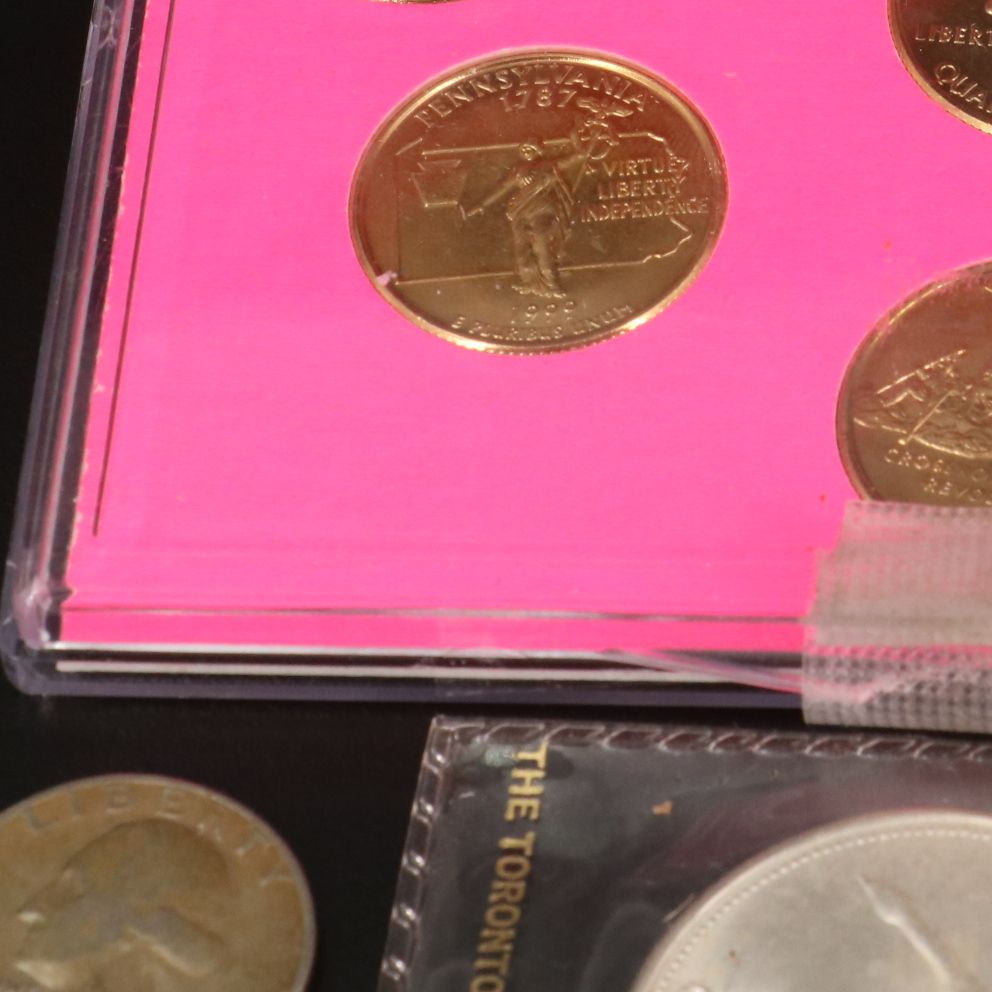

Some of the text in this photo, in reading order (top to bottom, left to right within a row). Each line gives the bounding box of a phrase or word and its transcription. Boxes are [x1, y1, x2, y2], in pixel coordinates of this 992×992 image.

[412, 62, 647, 131] PENNSYLVANIA
[500, 88, 578, 113] 1787
[601, 156, 678, 178] VIRTUE
[597, 176, 686, 200] LIBERTY
[470, 737, 549, 992] THE TORONTO
